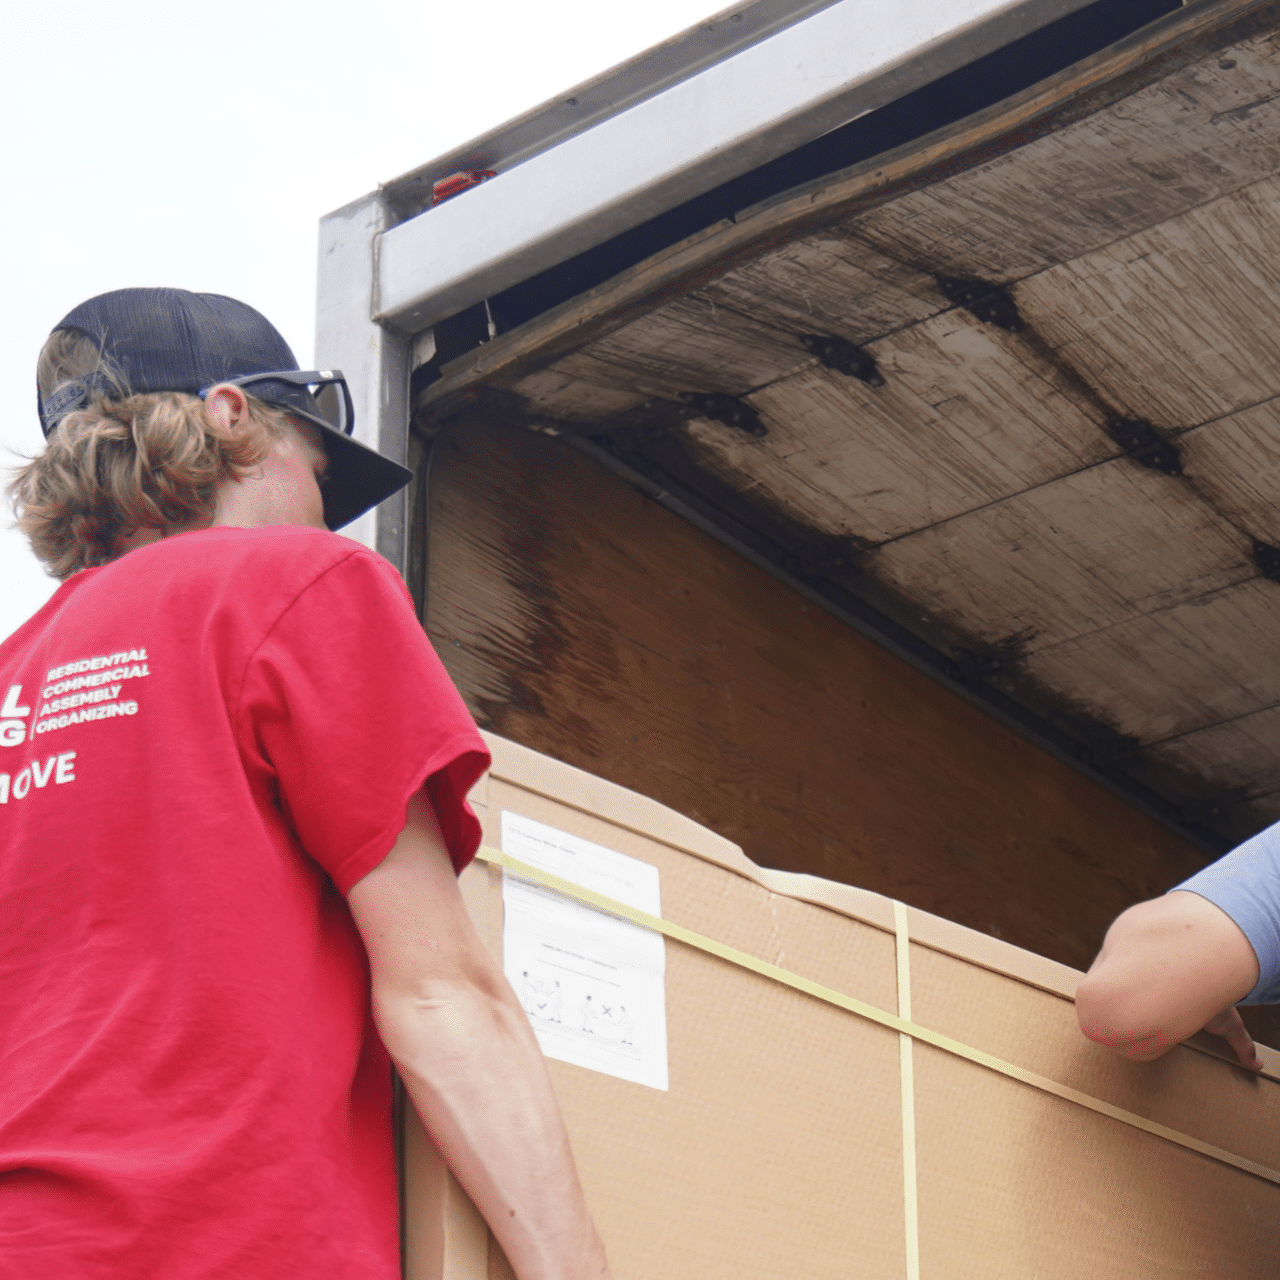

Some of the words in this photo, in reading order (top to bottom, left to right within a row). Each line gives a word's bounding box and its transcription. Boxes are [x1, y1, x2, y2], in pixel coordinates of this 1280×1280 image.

[43, 664, 150, 698] COMMERCIAL
[47, 648, 148, 682] RESIDENTIAL
[36, 701, 139, 733] ORGANIZING
[40, 684, 122, 717] ASSEMBLY
